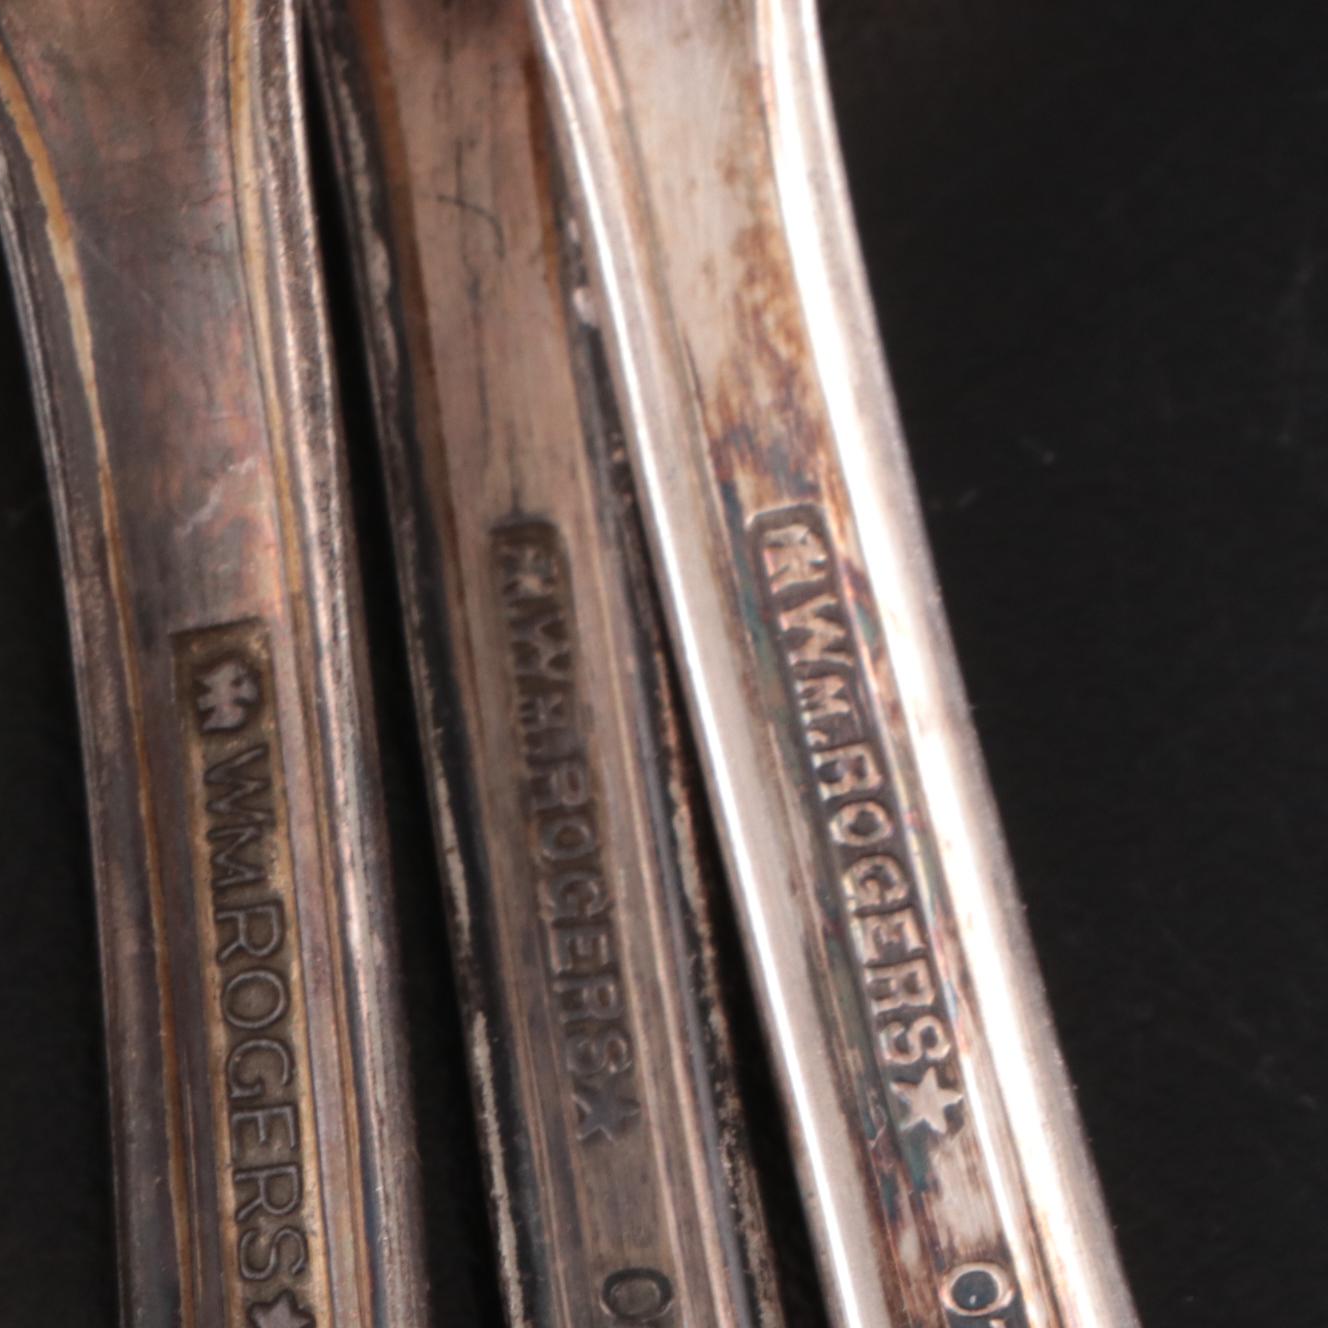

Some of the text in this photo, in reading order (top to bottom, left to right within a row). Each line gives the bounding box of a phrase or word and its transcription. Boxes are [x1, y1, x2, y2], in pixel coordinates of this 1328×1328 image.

[528, 760, 633, 1075] ROGERS
[812, 744, 951, 1064] ROGERS
[215, 900, 311, 1282] ROGERS
